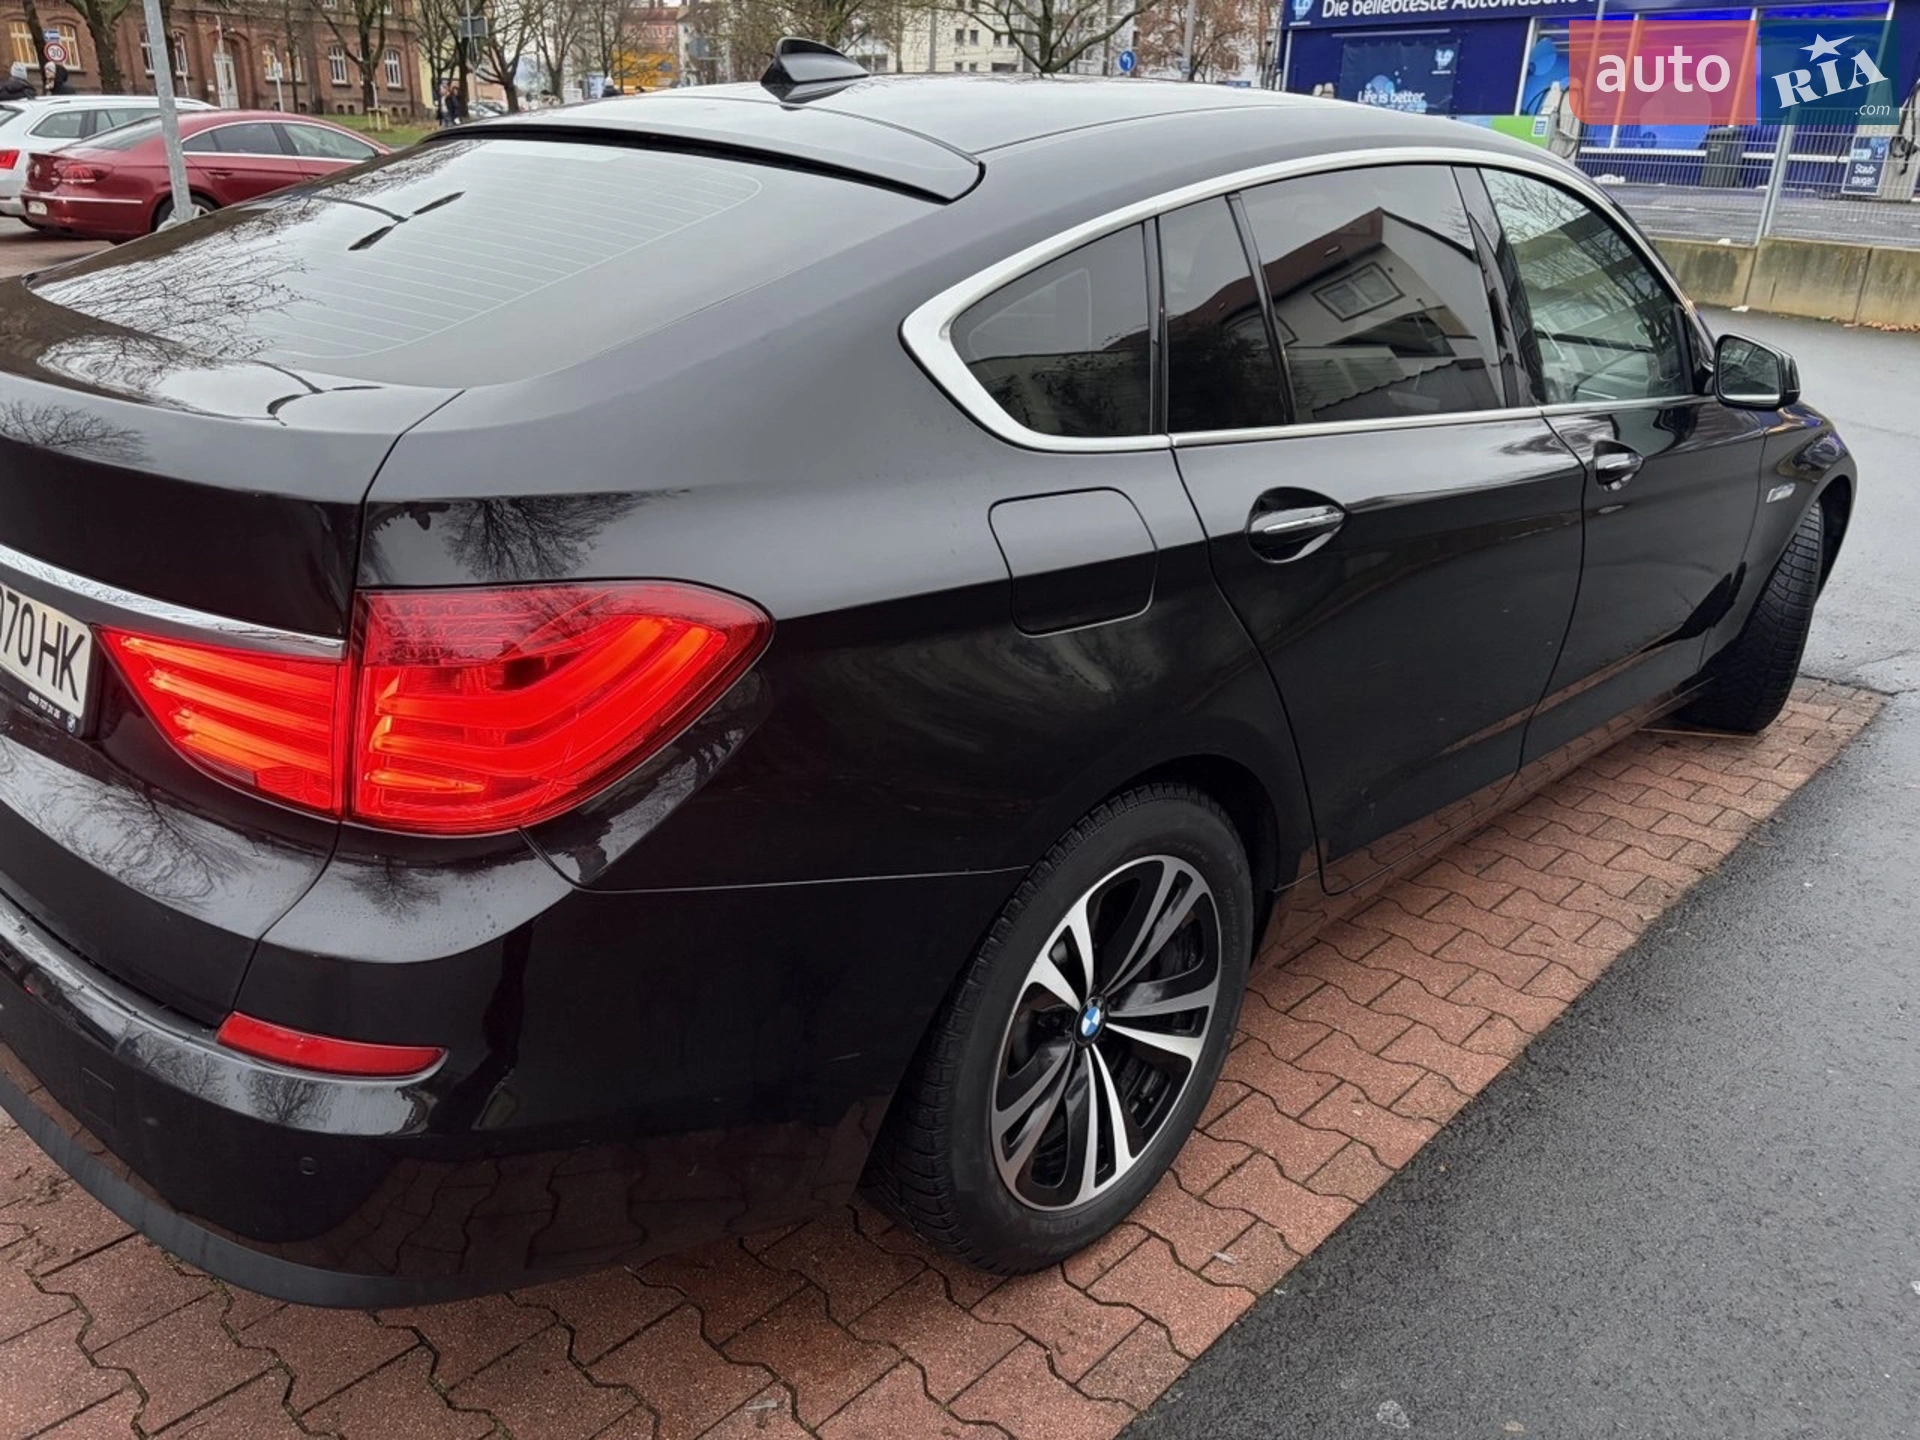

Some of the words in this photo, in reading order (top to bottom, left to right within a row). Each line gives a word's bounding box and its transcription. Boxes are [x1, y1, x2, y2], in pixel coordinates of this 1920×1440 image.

[1322, 0, 1349, 18] Die
[50, 47, 62, 58] 30
[1357, 90, 1378, 105] Life
[1379, 90, 1388, 104] is
